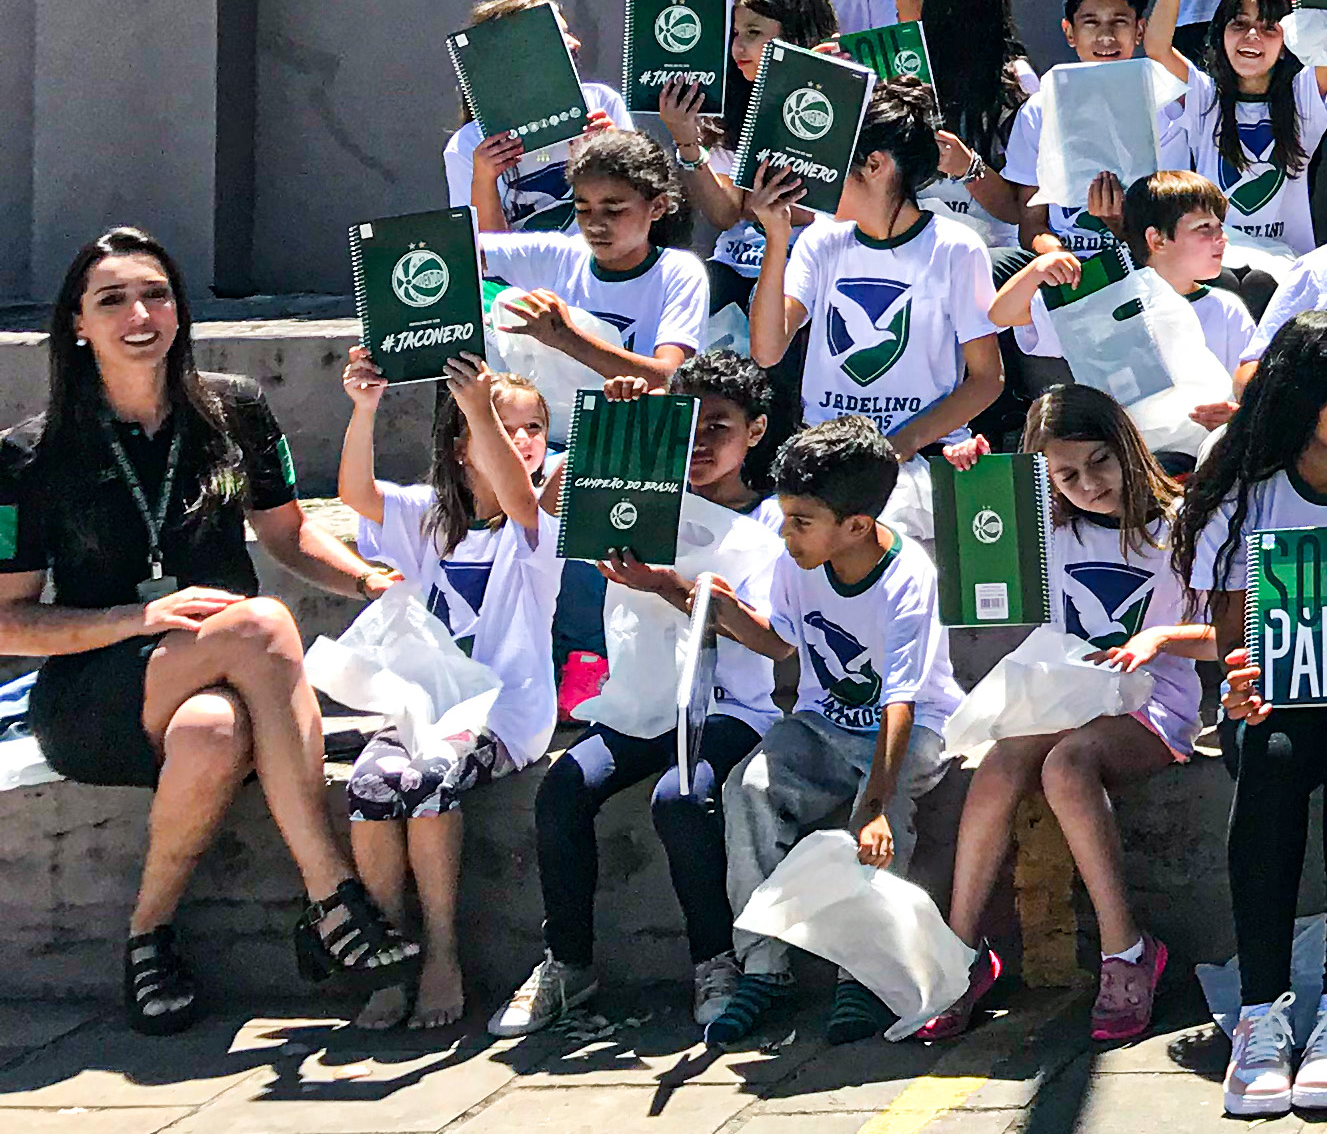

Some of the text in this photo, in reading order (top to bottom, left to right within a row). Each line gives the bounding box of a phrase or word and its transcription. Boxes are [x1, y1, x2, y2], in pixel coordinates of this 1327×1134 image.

[380, 323, 473, 353] #JACONERO
[574, 477, 679, 493] CAMPEÃO DO BRASIL
